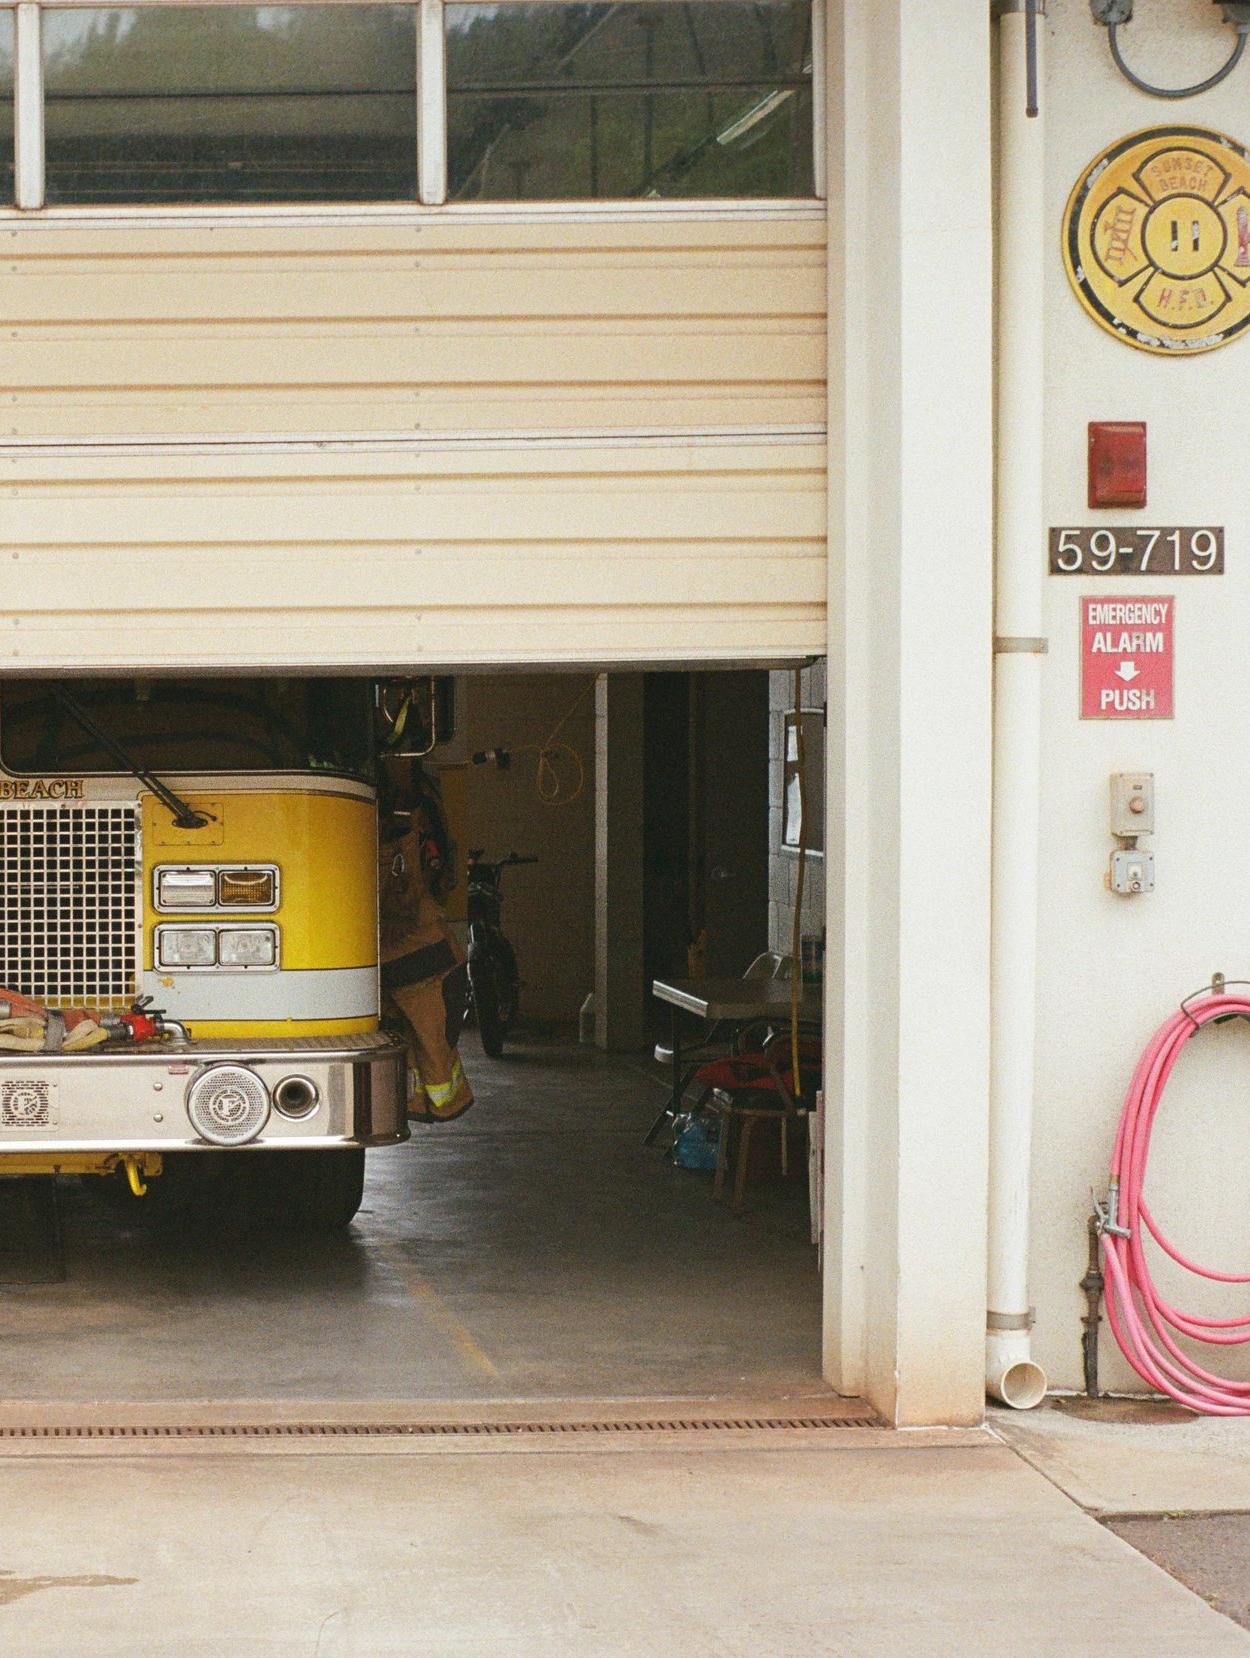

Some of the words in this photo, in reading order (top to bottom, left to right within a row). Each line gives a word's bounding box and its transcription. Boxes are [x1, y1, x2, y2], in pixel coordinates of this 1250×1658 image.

[1151, 157, 1214, 177] SUNSET
[1159, 175, 1208, 192] BEACH
[1171, 220, 1199, 252] 11
[1057, 529, 1217, 571] 59-719
[1088, 603, 1168, 625] EMERGENCY
[1091, 632, 1164, 653] ALARM
[1100, 689, 1155, 710] PUSH
